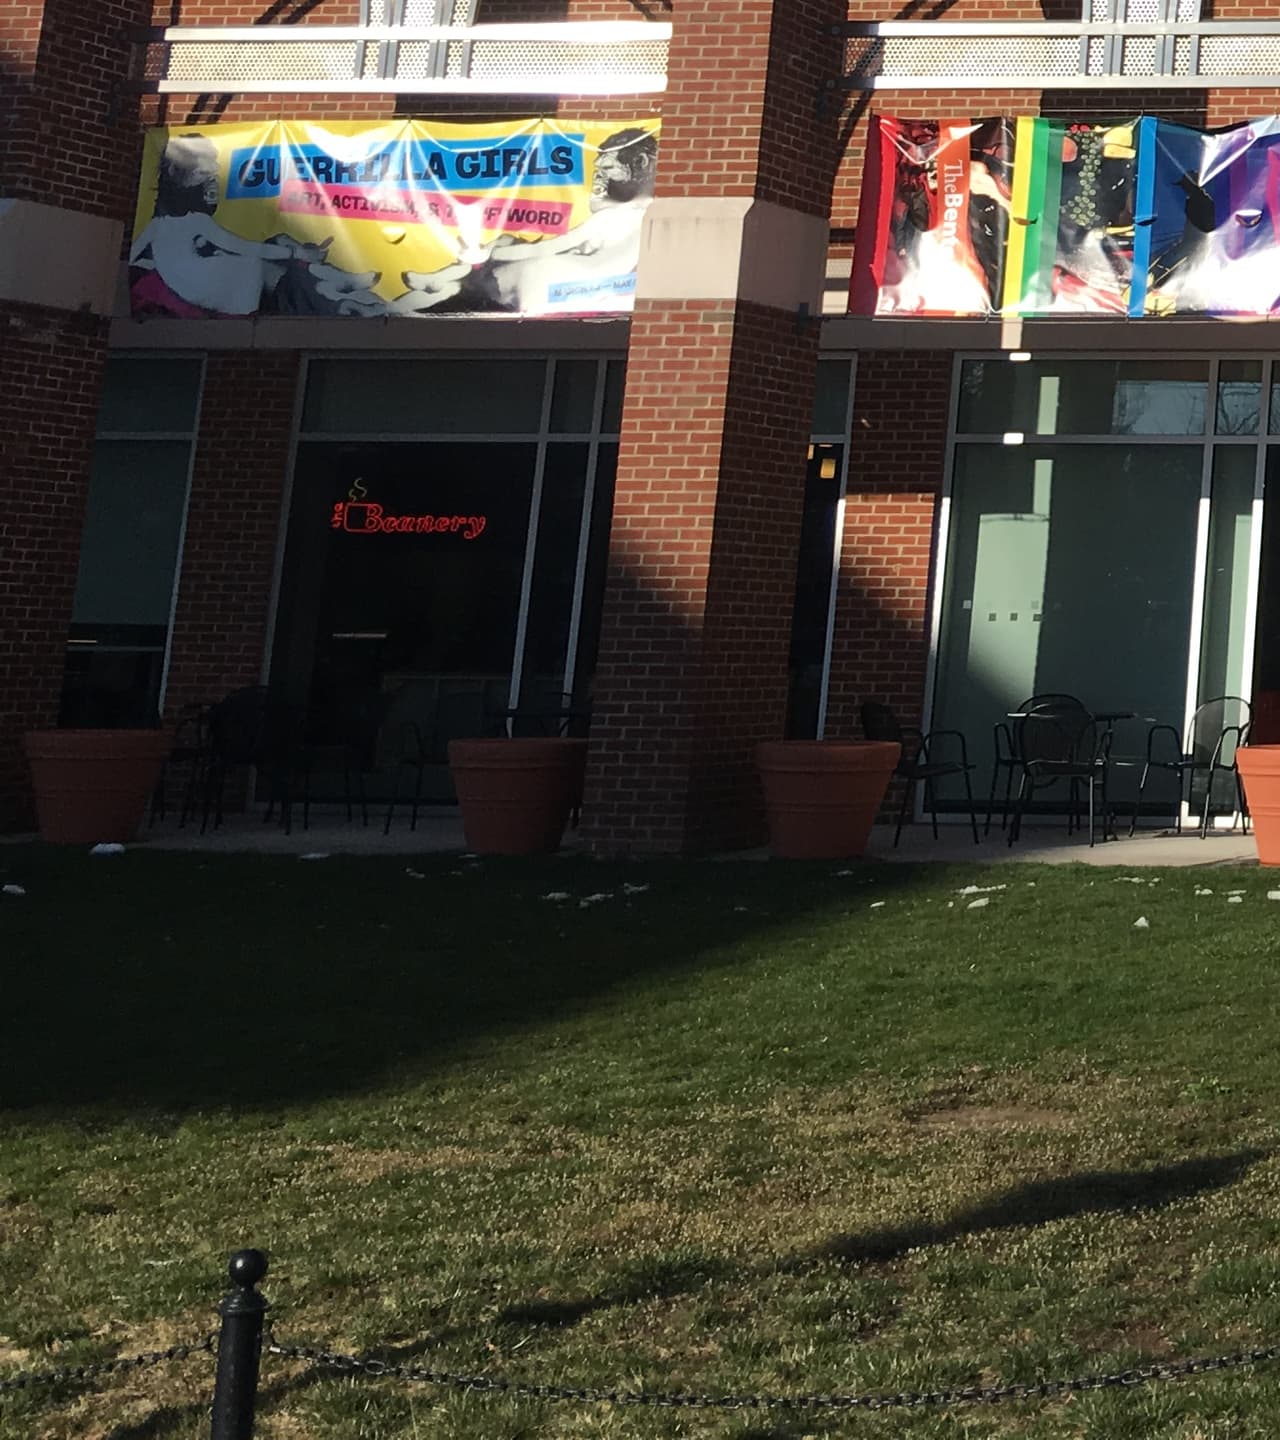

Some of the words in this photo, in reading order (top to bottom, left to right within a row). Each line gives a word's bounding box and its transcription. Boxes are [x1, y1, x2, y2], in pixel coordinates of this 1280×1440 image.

[455, 146, 574, 179] GIRLS
[943, 160, 964, 193] The
[506, 208, 563, 226] WORD
[365, 503, 487, 540] Beanery
